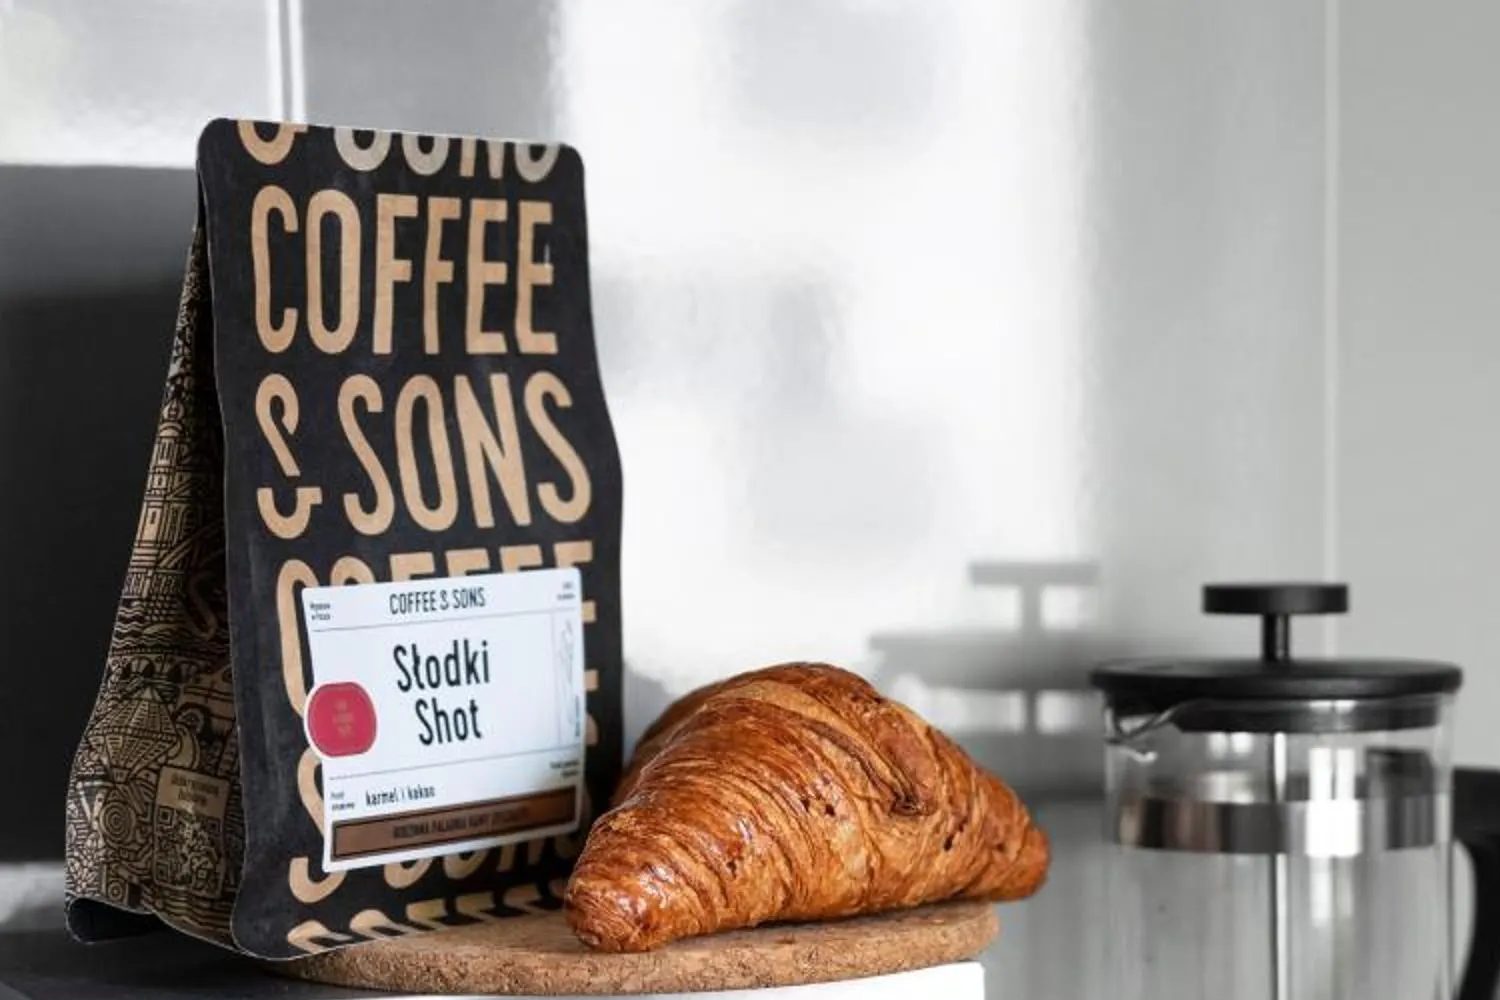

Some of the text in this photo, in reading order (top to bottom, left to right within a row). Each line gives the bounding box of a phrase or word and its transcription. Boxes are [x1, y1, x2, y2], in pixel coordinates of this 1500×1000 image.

[250, 184, 559, 355] COFFEE
[255, 370, 593, 540] & SONS
[389, 590, 437, 615] COFFEE
[452, 586, 486, 610] SONS
[393, 637, 491, 693] Słodki
[415, 696, 482, 746] Shot
